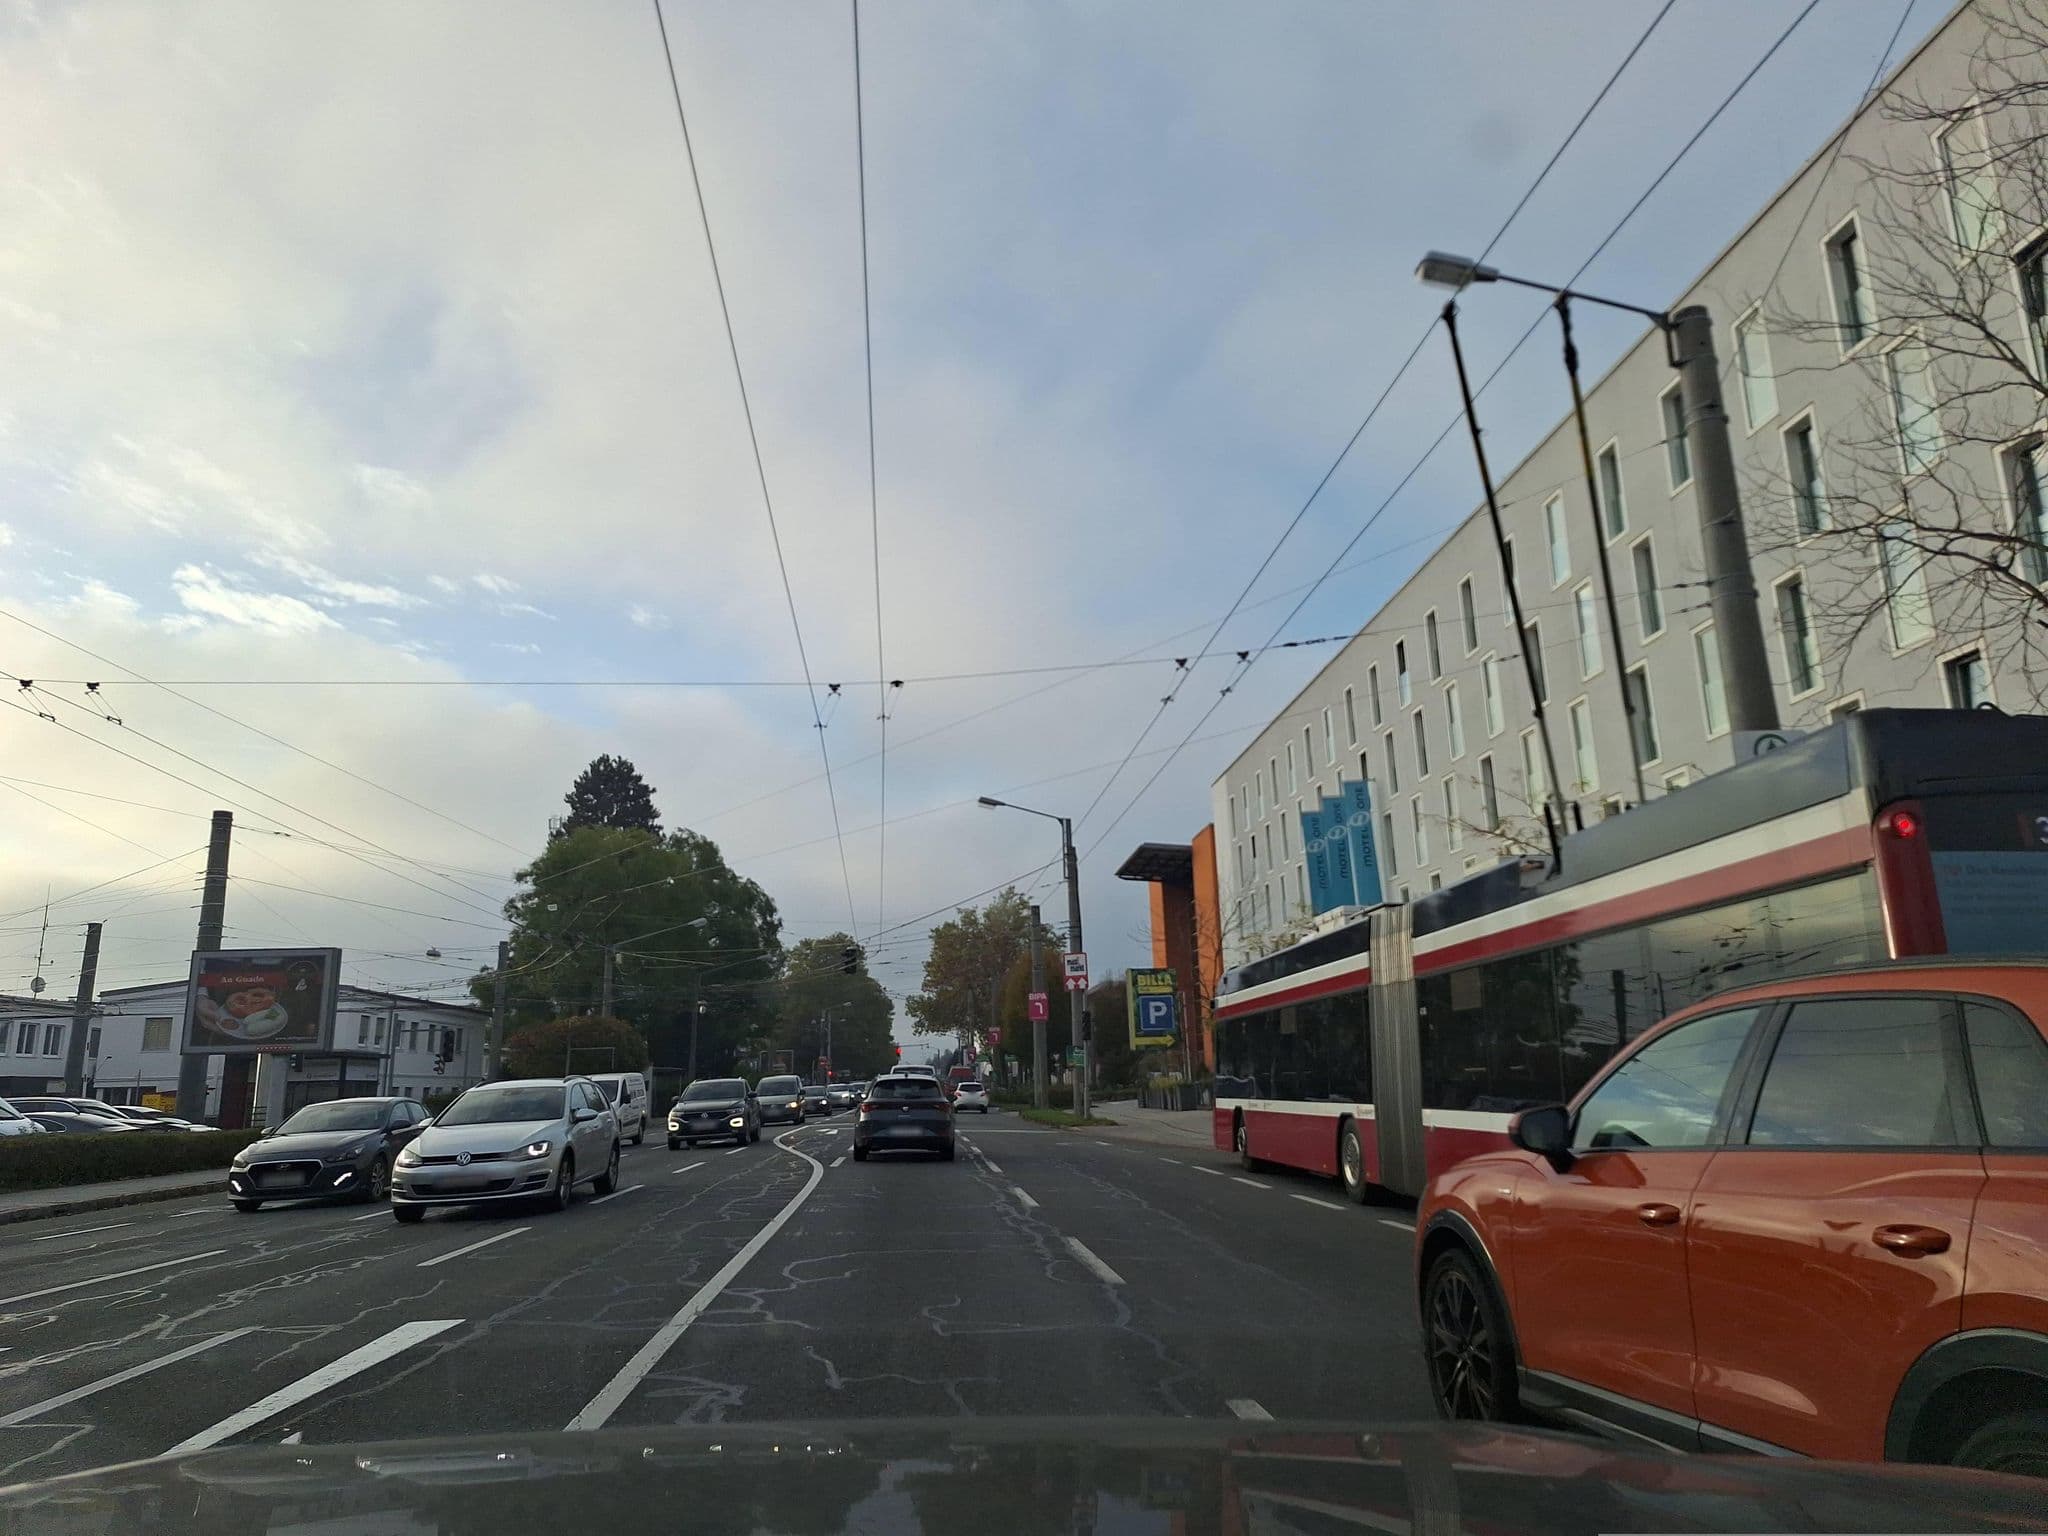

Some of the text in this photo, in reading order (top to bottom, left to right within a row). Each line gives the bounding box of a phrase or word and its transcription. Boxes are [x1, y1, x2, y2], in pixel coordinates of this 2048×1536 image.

[1137, 975, 1172, 986] BILLA
[1028, 992, 1047, 1000] BIPA
[1149, 1001, 1167, 1024] P
